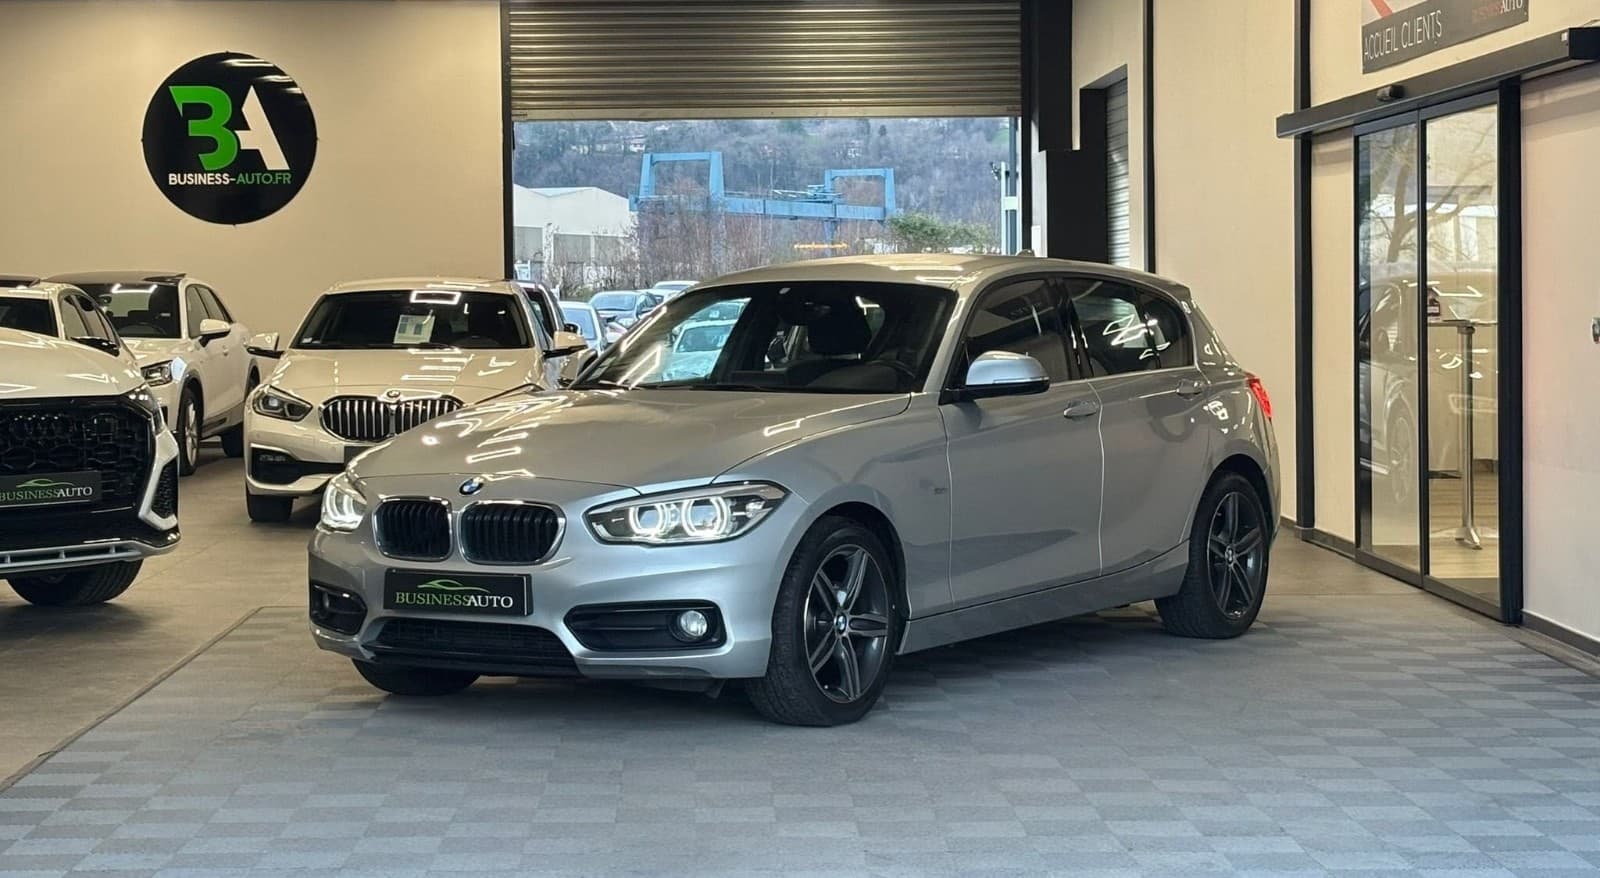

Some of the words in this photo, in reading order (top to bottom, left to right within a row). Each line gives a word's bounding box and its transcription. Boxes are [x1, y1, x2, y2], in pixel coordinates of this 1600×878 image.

[1364, 26, 1398, 60] ACCUEIL
[1401, 9, 1442, 48] CLIENTS
[168, 173, 292, 185] BUSINESS-AUTO.FR
